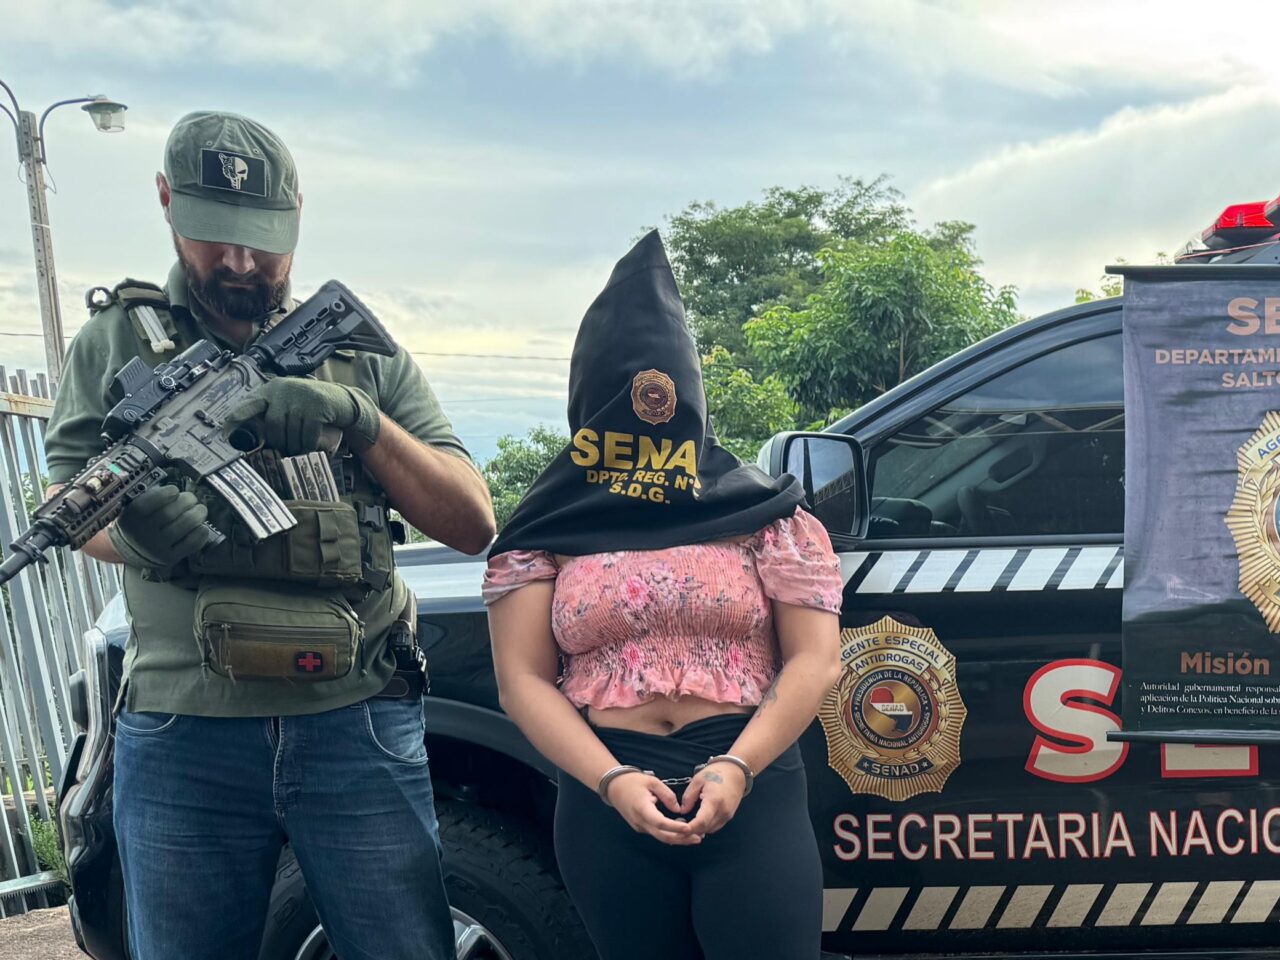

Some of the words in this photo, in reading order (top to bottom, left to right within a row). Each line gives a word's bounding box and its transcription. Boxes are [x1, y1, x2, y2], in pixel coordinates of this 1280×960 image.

[633, 470, 669, 486] REG.
[609, 482, 671, 504] S.D.G.
[884, 636, 940, 664] ESPECIAL
[855, 653, 924, 671] ANTIDROGAS
[1180, 651, 1270, 675] Misión
[1140, 681, 1180, 691] Autoridad
[1184, 683, 1241, 693] gubernamental
[1140, 693, 1178, 704] aplicación
[1179, 694, 1189, 702] de
[1190, 694, 1197, 703] la
[1199, 694, 1227, 703] Política
[1229, 694, 1263, 704] Nacional
[1141, 706, 1145, 715] y
[1147, 705, 1175, 713] Delitos
[1224, 706, 1258, 715] beneficio
[1259, 707, 1270, 715] de
[1270, 707, 1277, 715] la
[871, 762, 920, 777] SENAD
[833, 811, 1136, 861] SECRETARIA
